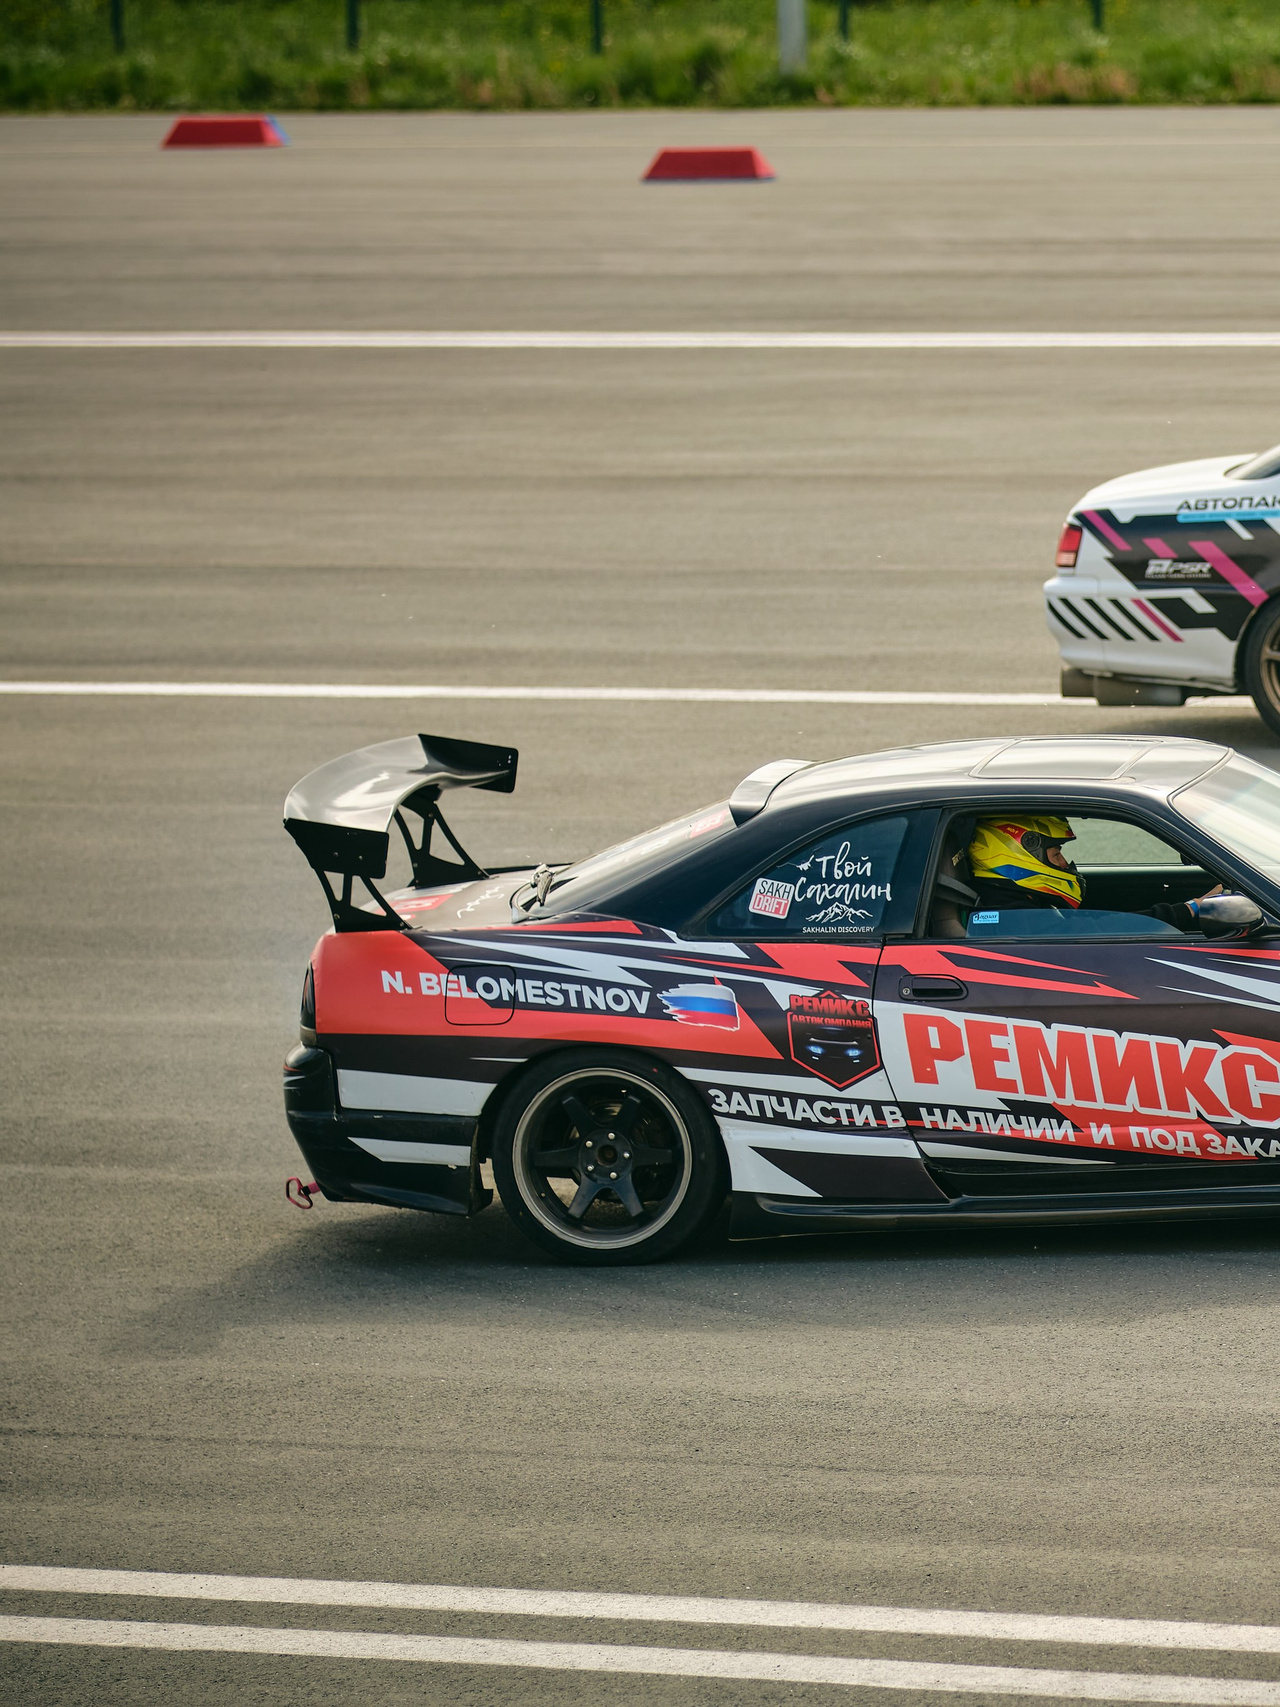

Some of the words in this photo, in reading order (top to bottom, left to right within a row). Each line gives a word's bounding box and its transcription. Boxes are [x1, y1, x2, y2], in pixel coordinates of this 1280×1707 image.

[816, 841, 872, 879] Твой
[760, 880, 793, 900] SAKH
[794, 877, 892, 905] Сахалин
[754, 895, 788, 915] DRIFT
[381, 970, 413, 994] N.
[419, 972, 650, 1015] BELOMESTNOV
[789, 994, 870, 1017] РЕМИКС
[792, 1014, 872, 1028] АВТОКОМПАНИЯ
[707, 1089, 878, 1127] ЗАПЧАСТИ
[881, 1105, 907, 1128] В
[919, 1107, 1075, 1142] НАЛИЧИИ
[1090, 1123, 1114, 1145] И
[1130, 1126, 1202, 1156] ПОД
